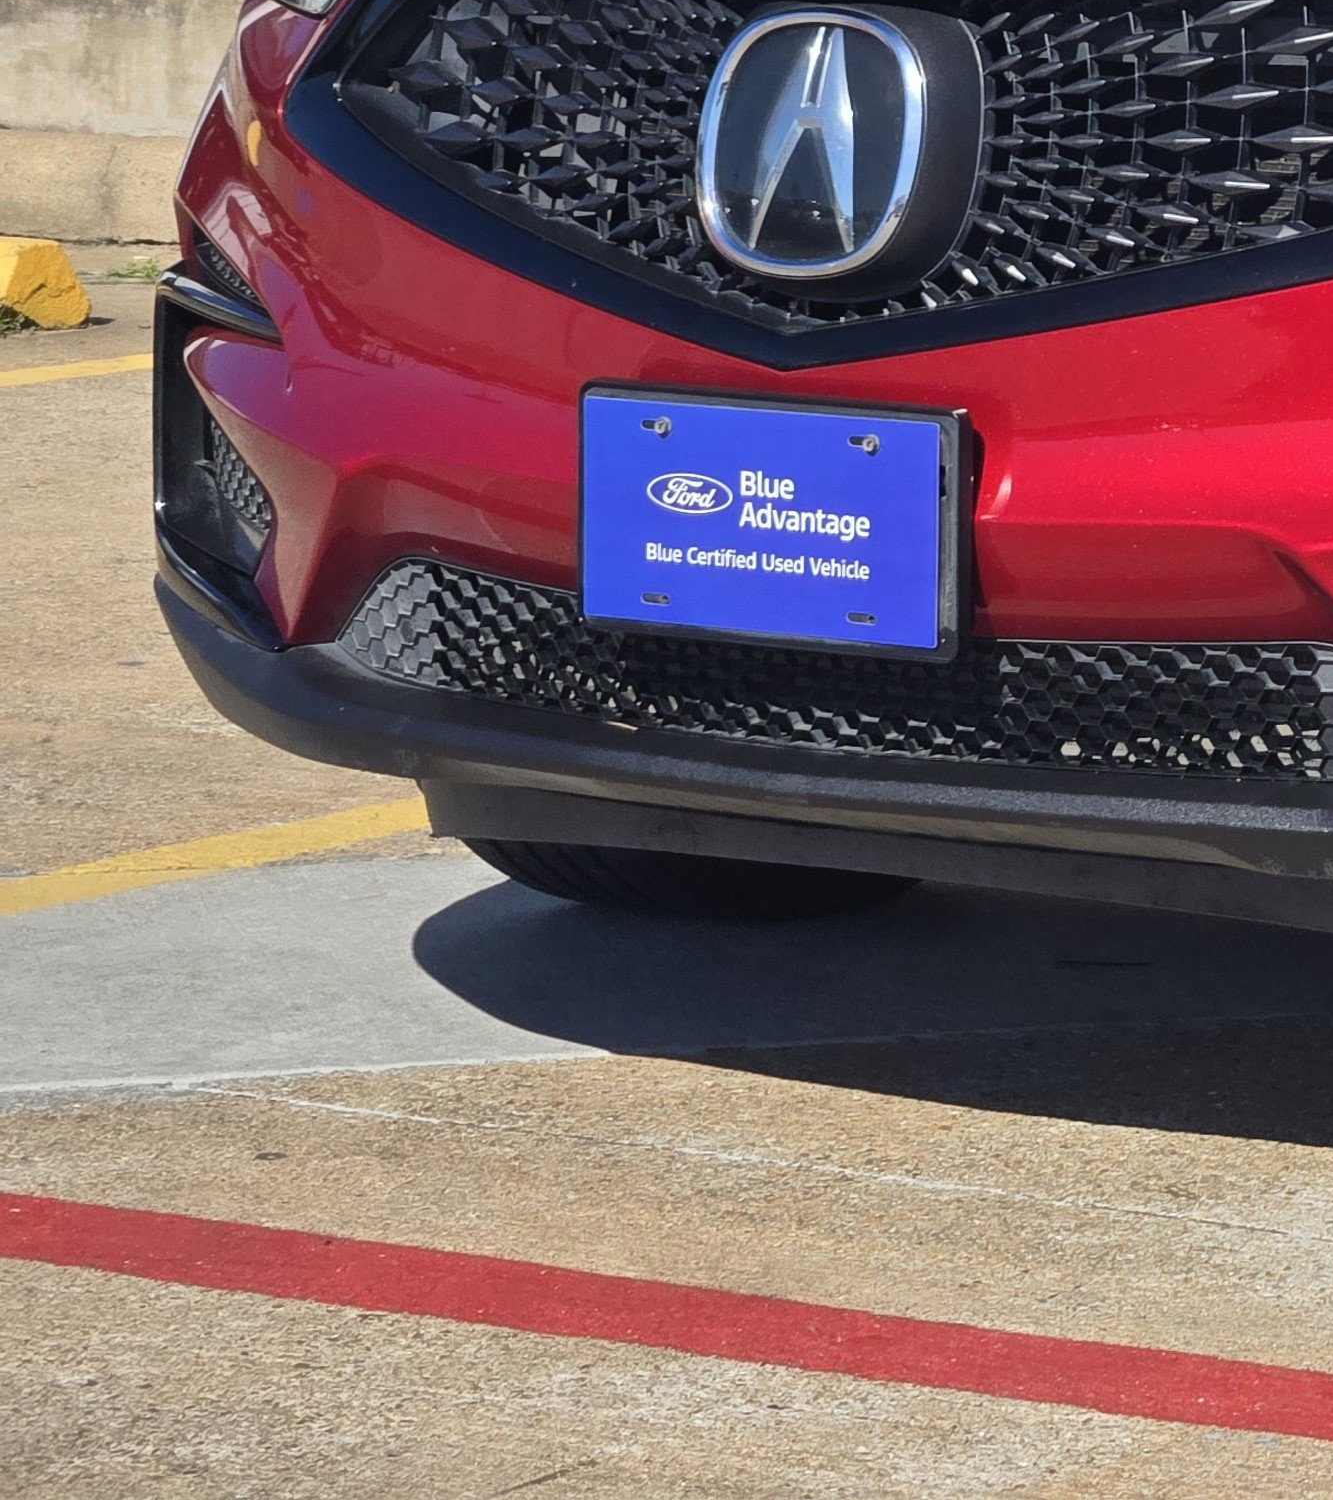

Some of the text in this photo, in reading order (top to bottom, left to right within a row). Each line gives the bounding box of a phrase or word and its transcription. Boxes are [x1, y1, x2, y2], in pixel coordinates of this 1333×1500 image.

[662, 477, 717, 509] Ford
[739, 469, 795, 500] Blue
[738, 501, 871, 542] Advantage
[645, 542, 870, 580] Blue Certified Used Vehicle
